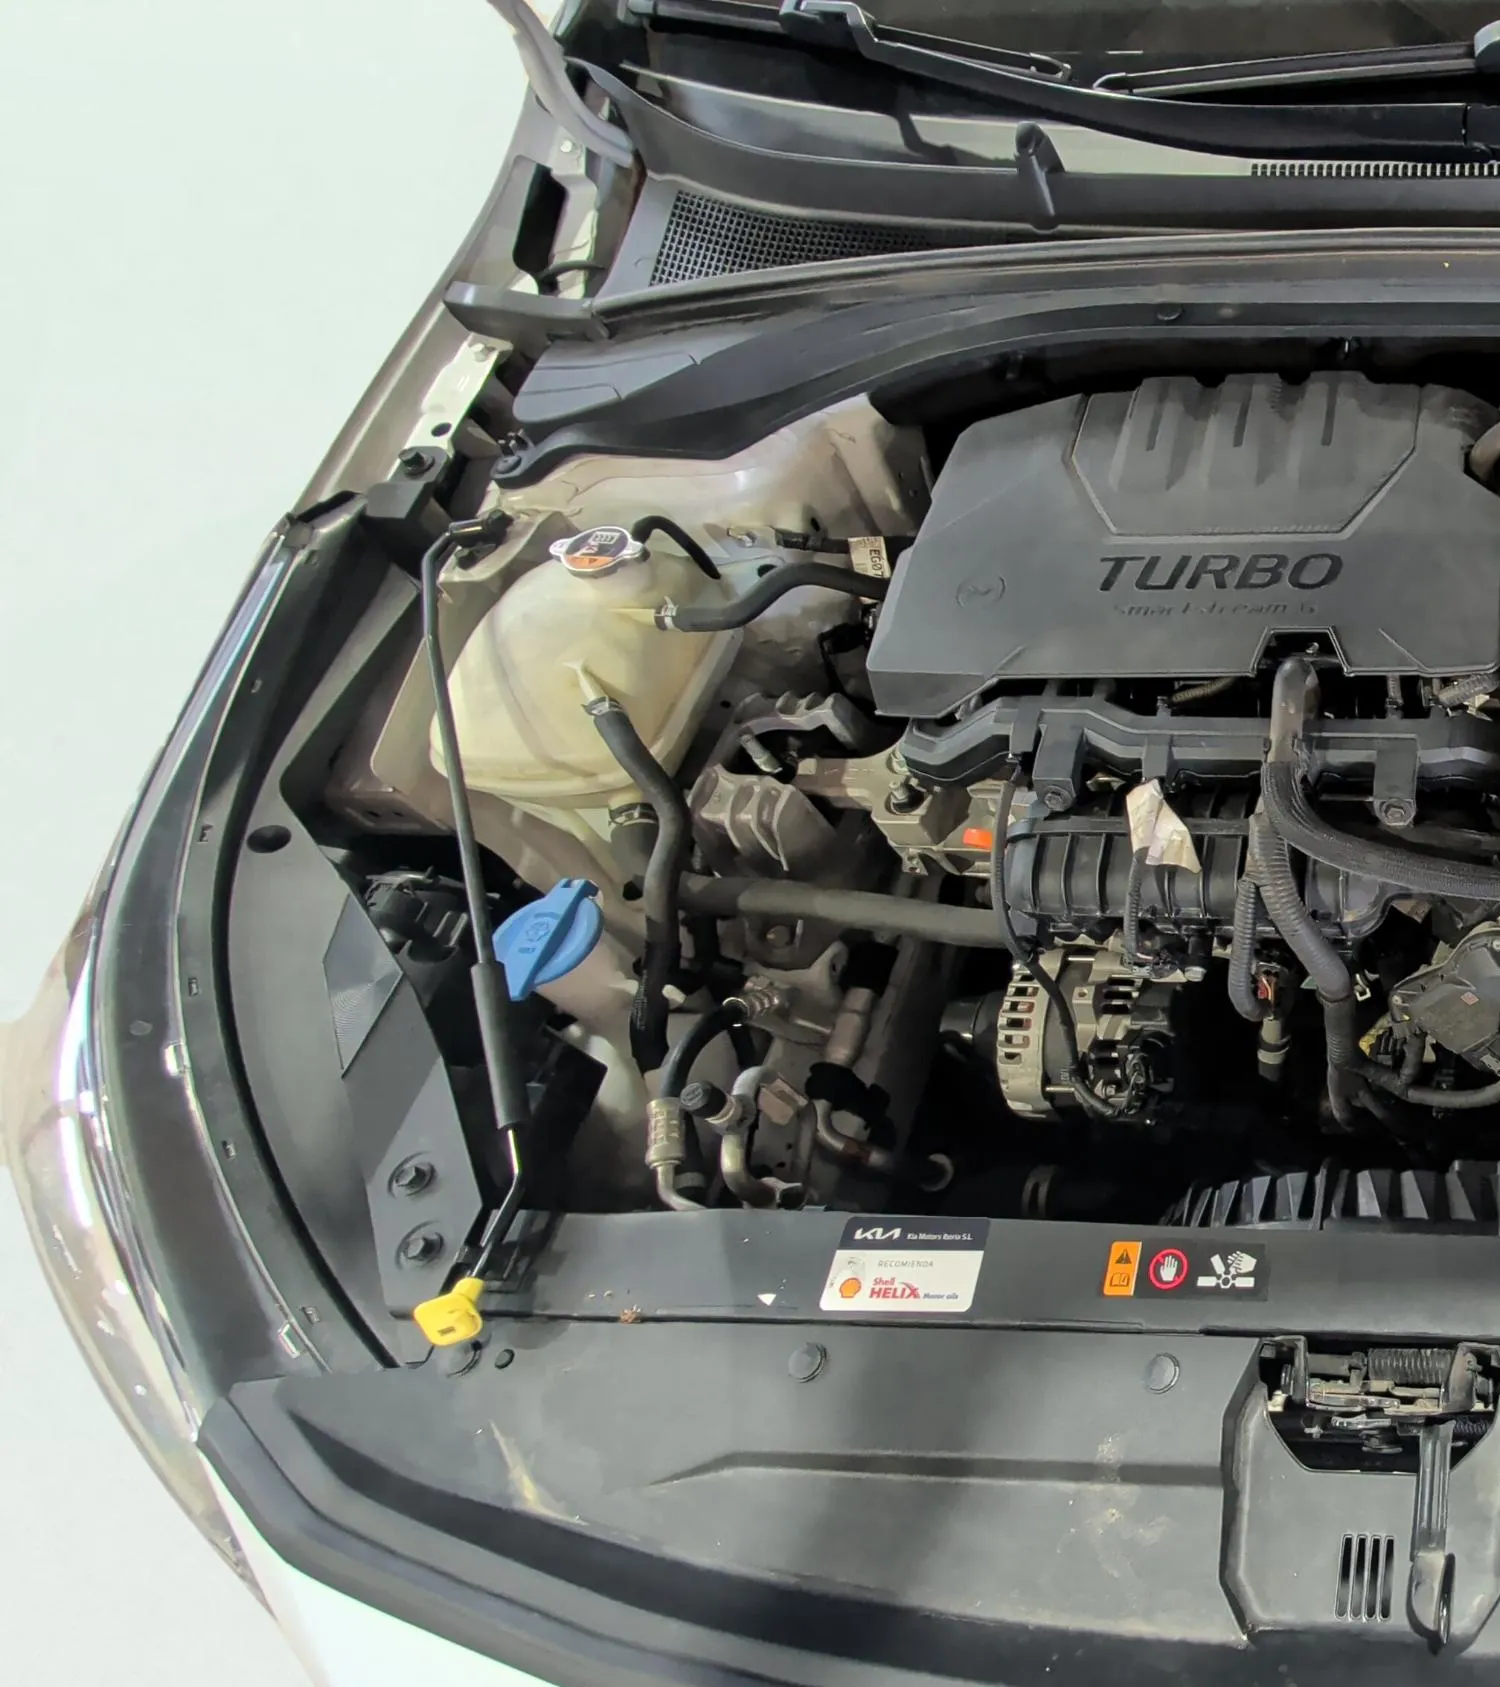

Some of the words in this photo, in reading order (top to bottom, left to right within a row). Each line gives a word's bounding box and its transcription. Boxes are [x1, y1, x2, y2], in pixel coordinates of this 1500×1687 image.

[1097, 553, 1343, 592] TURBO
[854, 1227, 902, 1240] KIA
[877, 1260, 934, 1269] RECOMIENDA
[872, 1277, 896, 1286] Shell
[869, 1285, 920, 1299] HELIX
